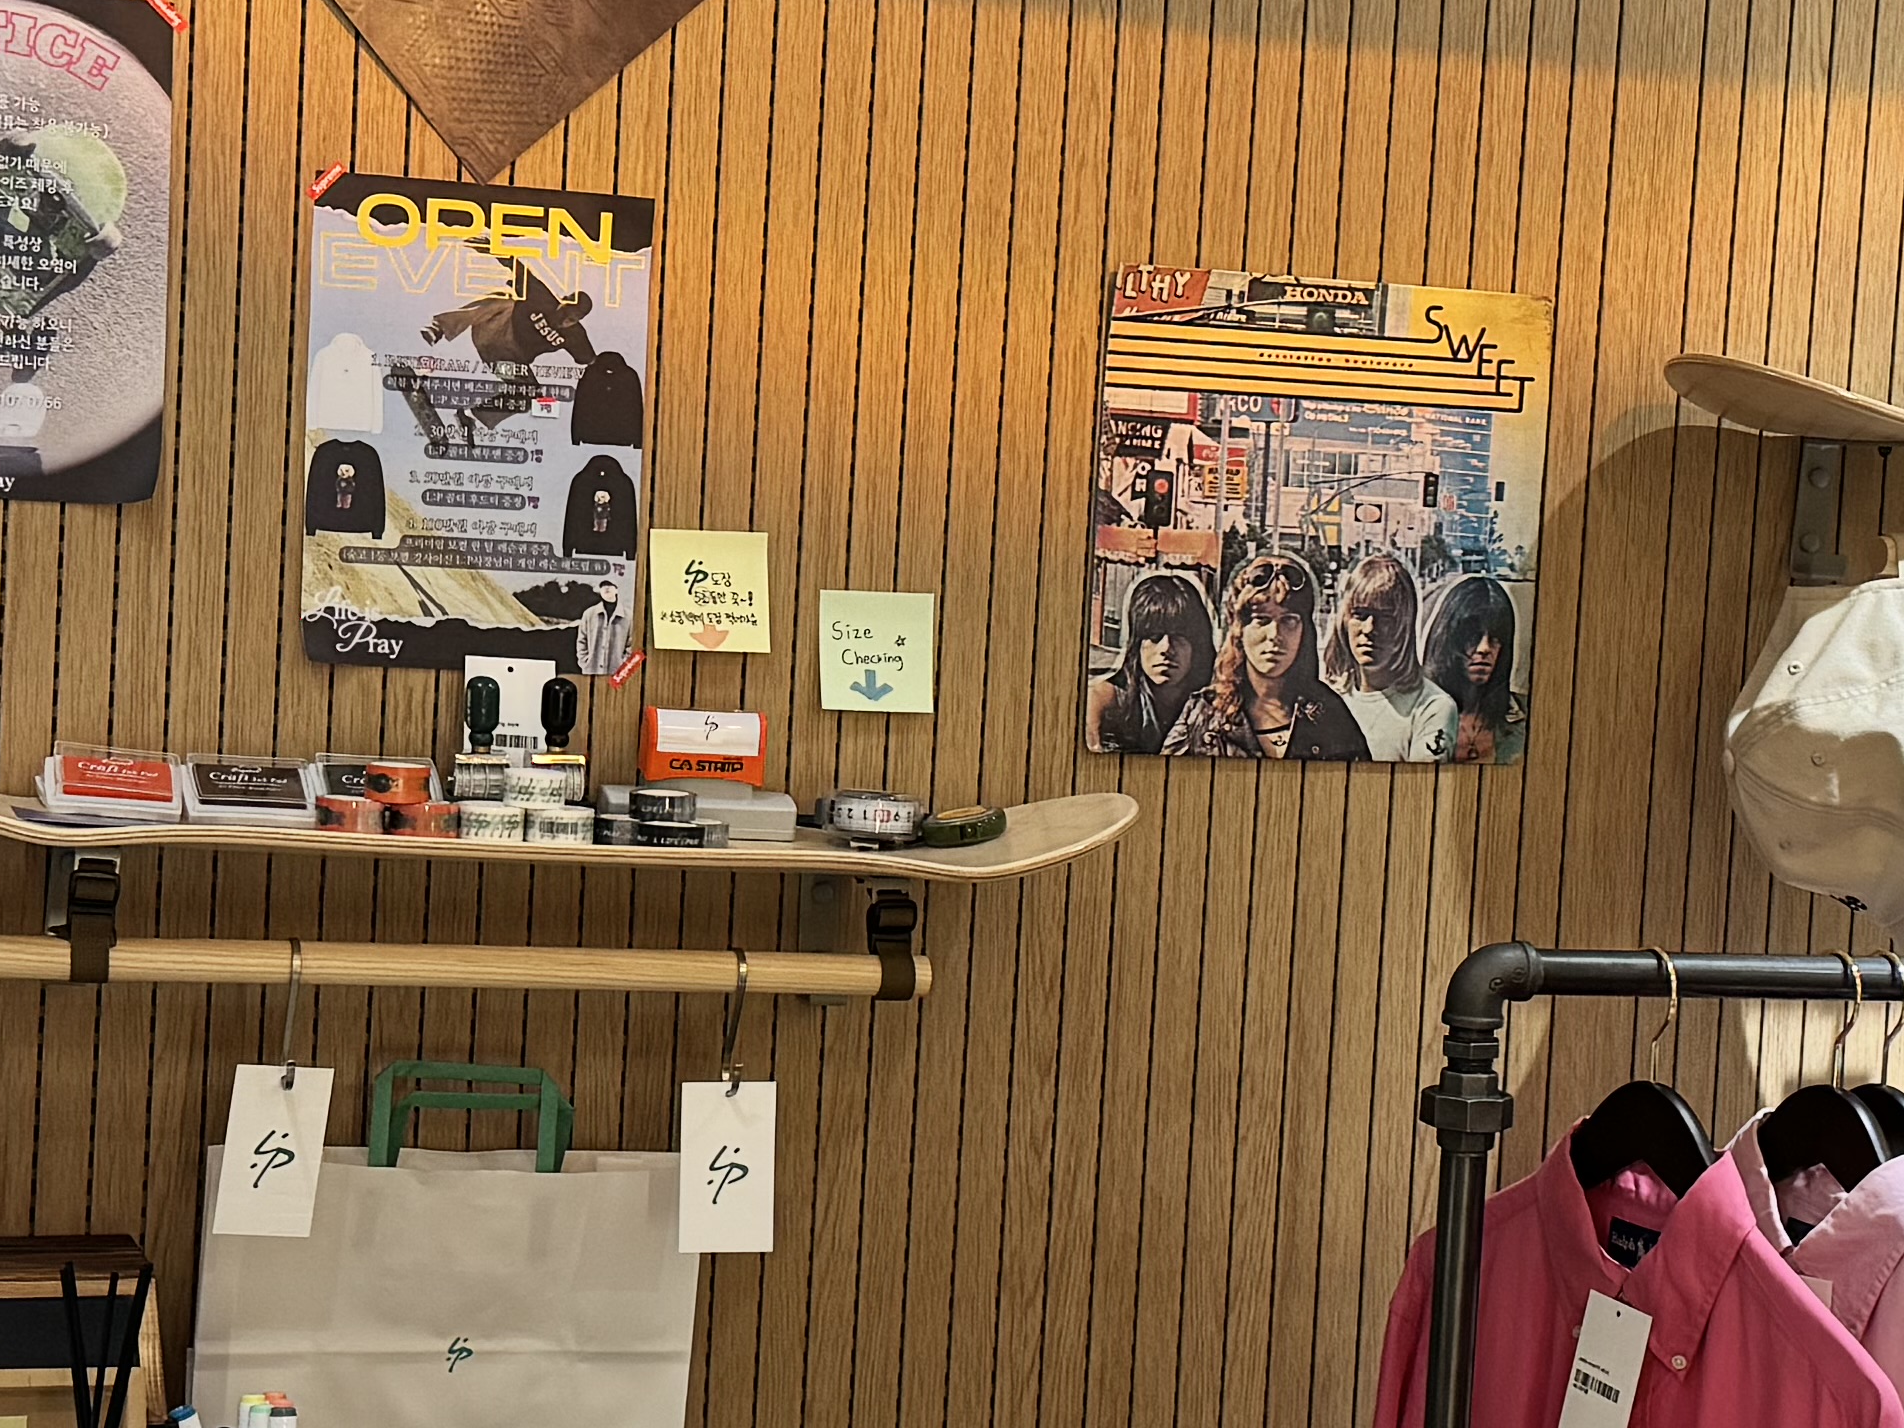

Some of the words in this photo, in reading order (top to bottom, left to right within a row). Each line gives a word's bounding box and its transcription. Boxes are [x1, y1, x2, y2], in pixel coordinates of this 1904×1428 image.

[357, 192, 614, 264] OPEN
[319, 231, 647, 308] EVENT
[1284, 285, 1369, 305] HONDA
[530, 311, 567, 347] JESUS
[334, 620, 404, 659] Pray
[831, 620, 873, 640] Size
[841, 648, 904, 672] Checking
[77, 760, 121, 775] Craft
[209, 771, 250, 784] Craft
